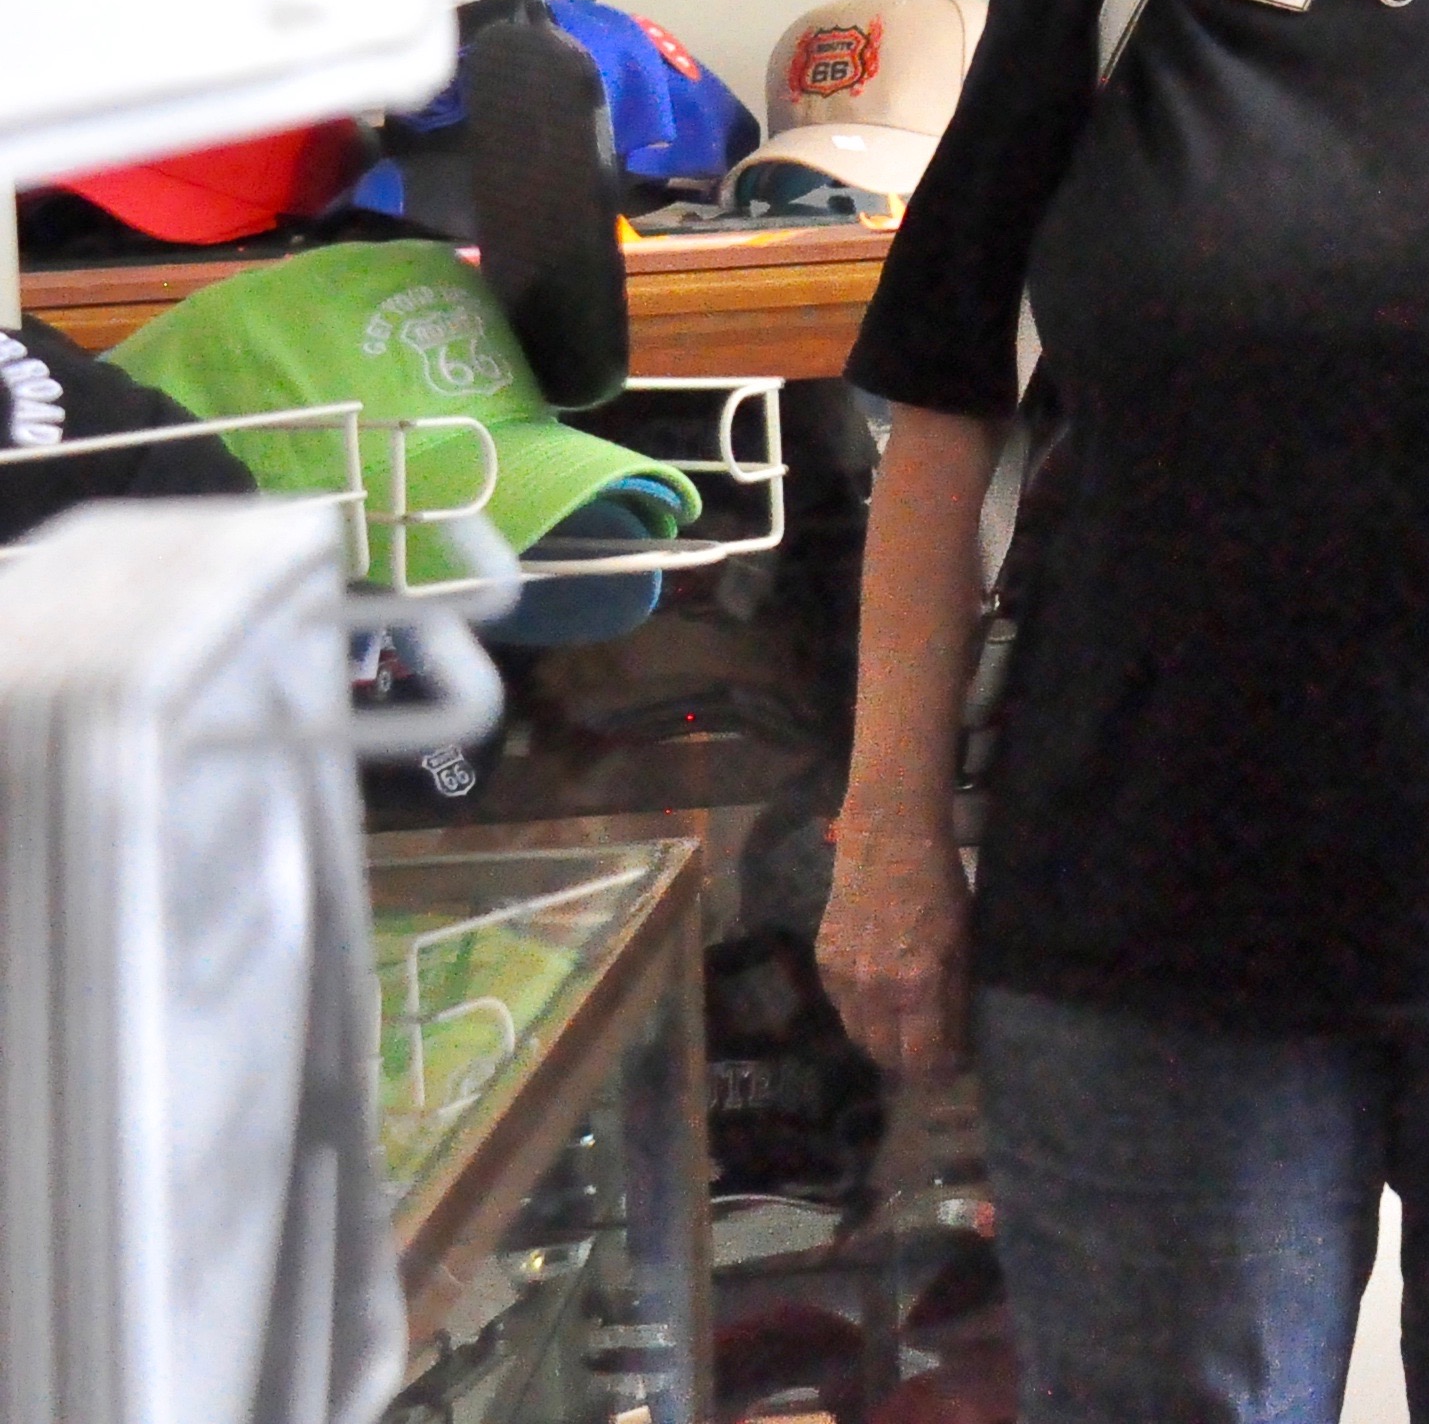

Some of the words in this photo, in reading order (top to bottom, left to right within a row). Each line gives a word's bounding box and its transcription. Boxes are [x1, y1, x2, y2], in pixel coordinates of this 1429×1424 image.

[811, 60, 850, 84] 66
[439, 339, 501, 385] 66
[440, 763, 470, 791] 66
